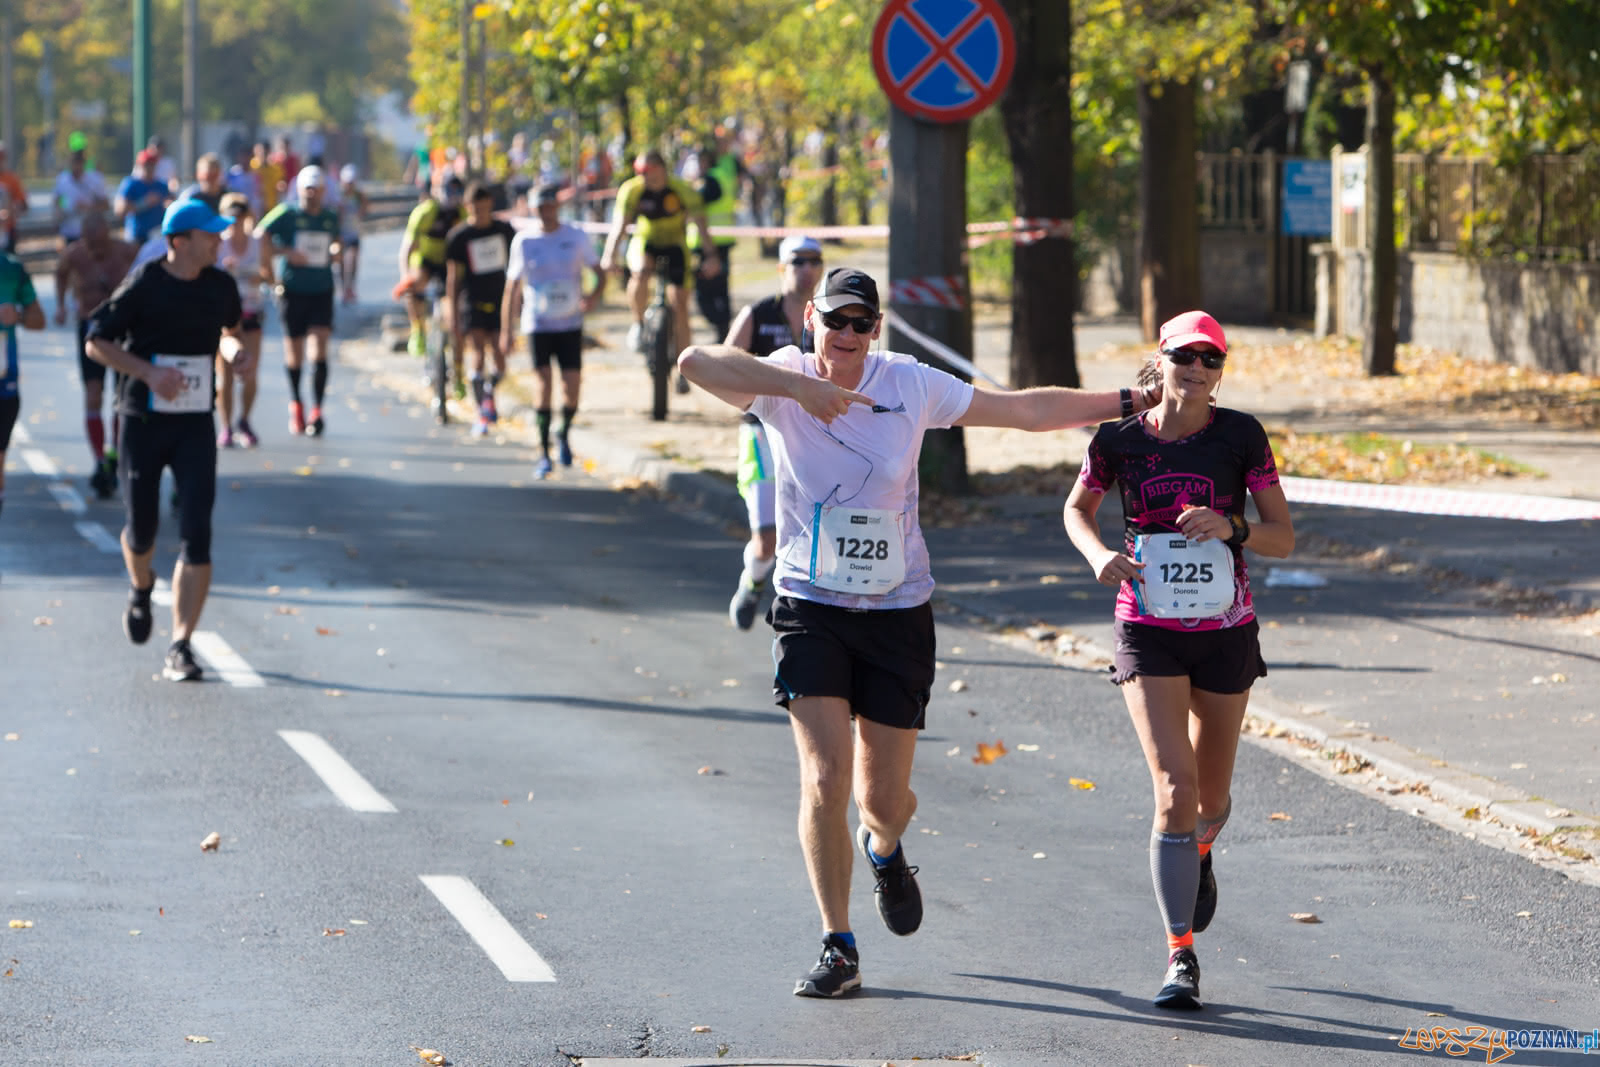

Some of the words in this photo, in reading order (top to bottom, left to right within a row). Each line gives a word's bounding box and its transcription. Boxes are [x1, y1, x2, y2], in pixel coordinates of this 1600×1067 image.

[1145, 481, 1208, 497] BIEGAM
[836, 537, 889, 560] 1228
[849, 563, 872, 571] Dawid
[1160, 563, 1214, 583] 1225
[1173, 587, 1198, 595] Dorota
